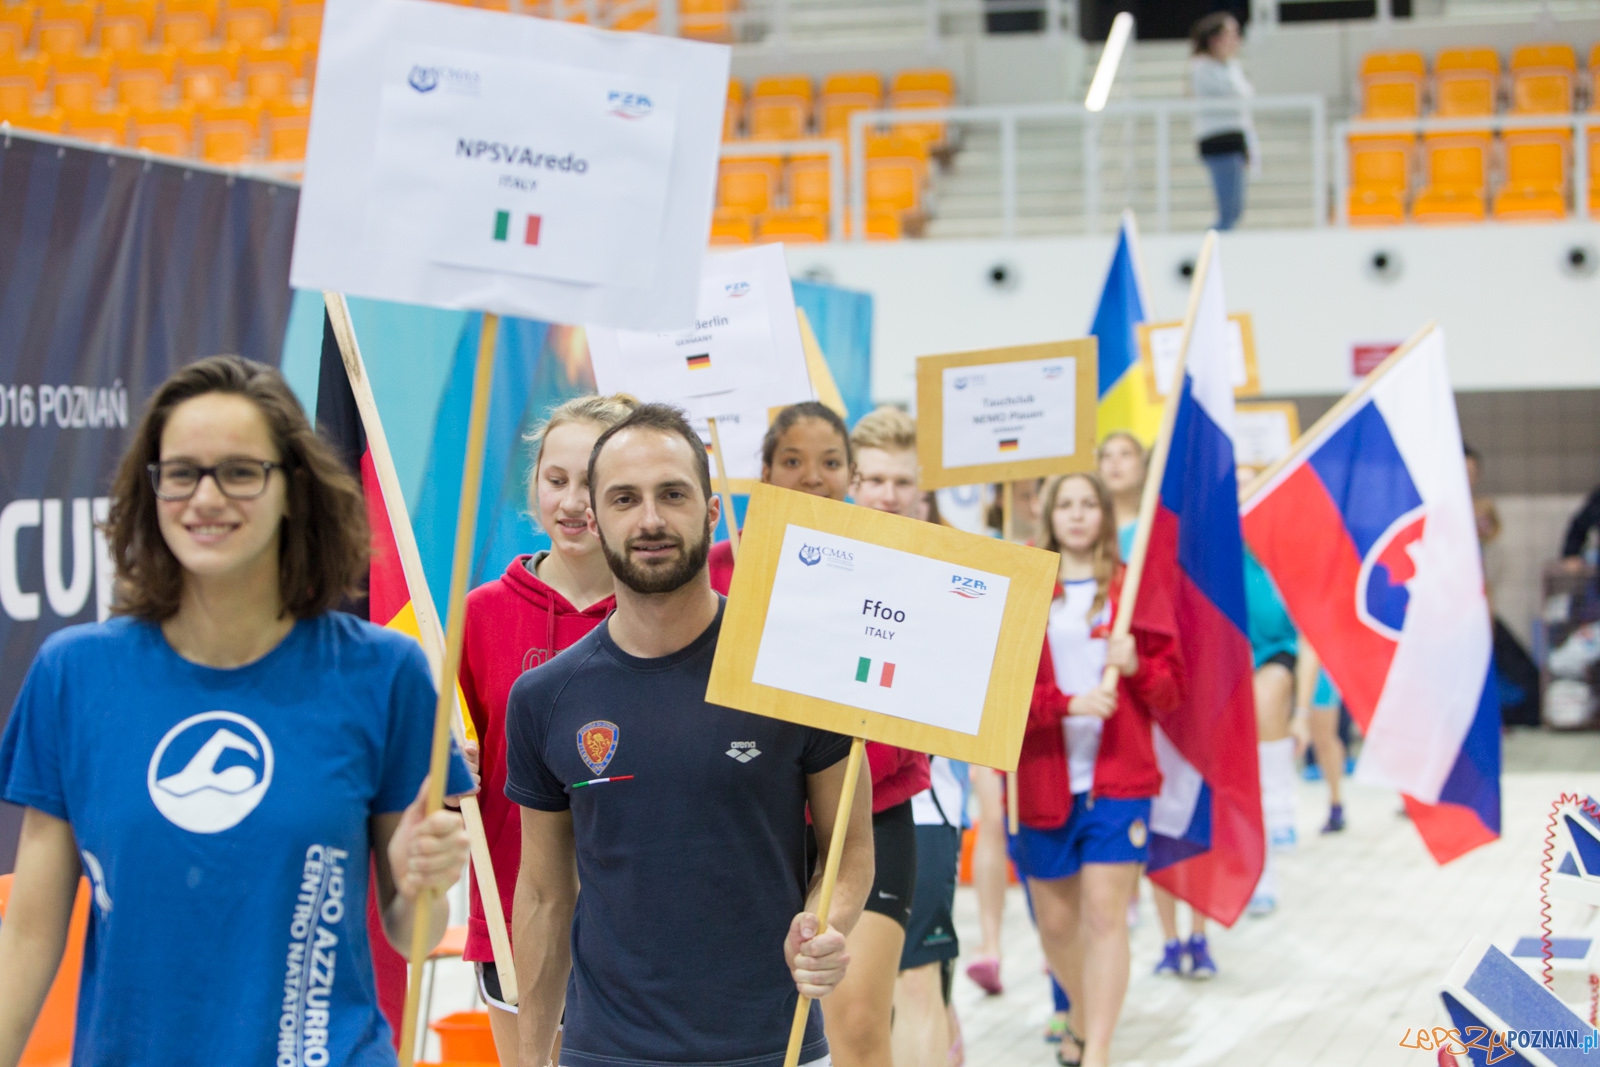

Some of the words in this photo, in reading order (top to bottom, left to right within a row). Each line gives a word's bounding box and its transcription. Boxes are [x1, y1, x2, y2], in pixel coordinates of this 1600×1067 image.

[456, 137, 590, 174] NPSVAredo
[498, 175, 539, 193] ITALY
[675, 334, 713, 347] GERMANY
[39, 378, 129, 429] POZNAŃ
[821, 546, 854, 561] CMAS
[862, 599, 906, 623] Ffoo
[864, 626, 895, 640] ITALY
[730, 740, 756, 749] arena
[290, 844, 324, 940] CENTRO
[320, 846, 348, 924] LIDO
[276, 942, 305, 1067] NATATORIO
[303, 925, 338, 1067] AZZURRO
